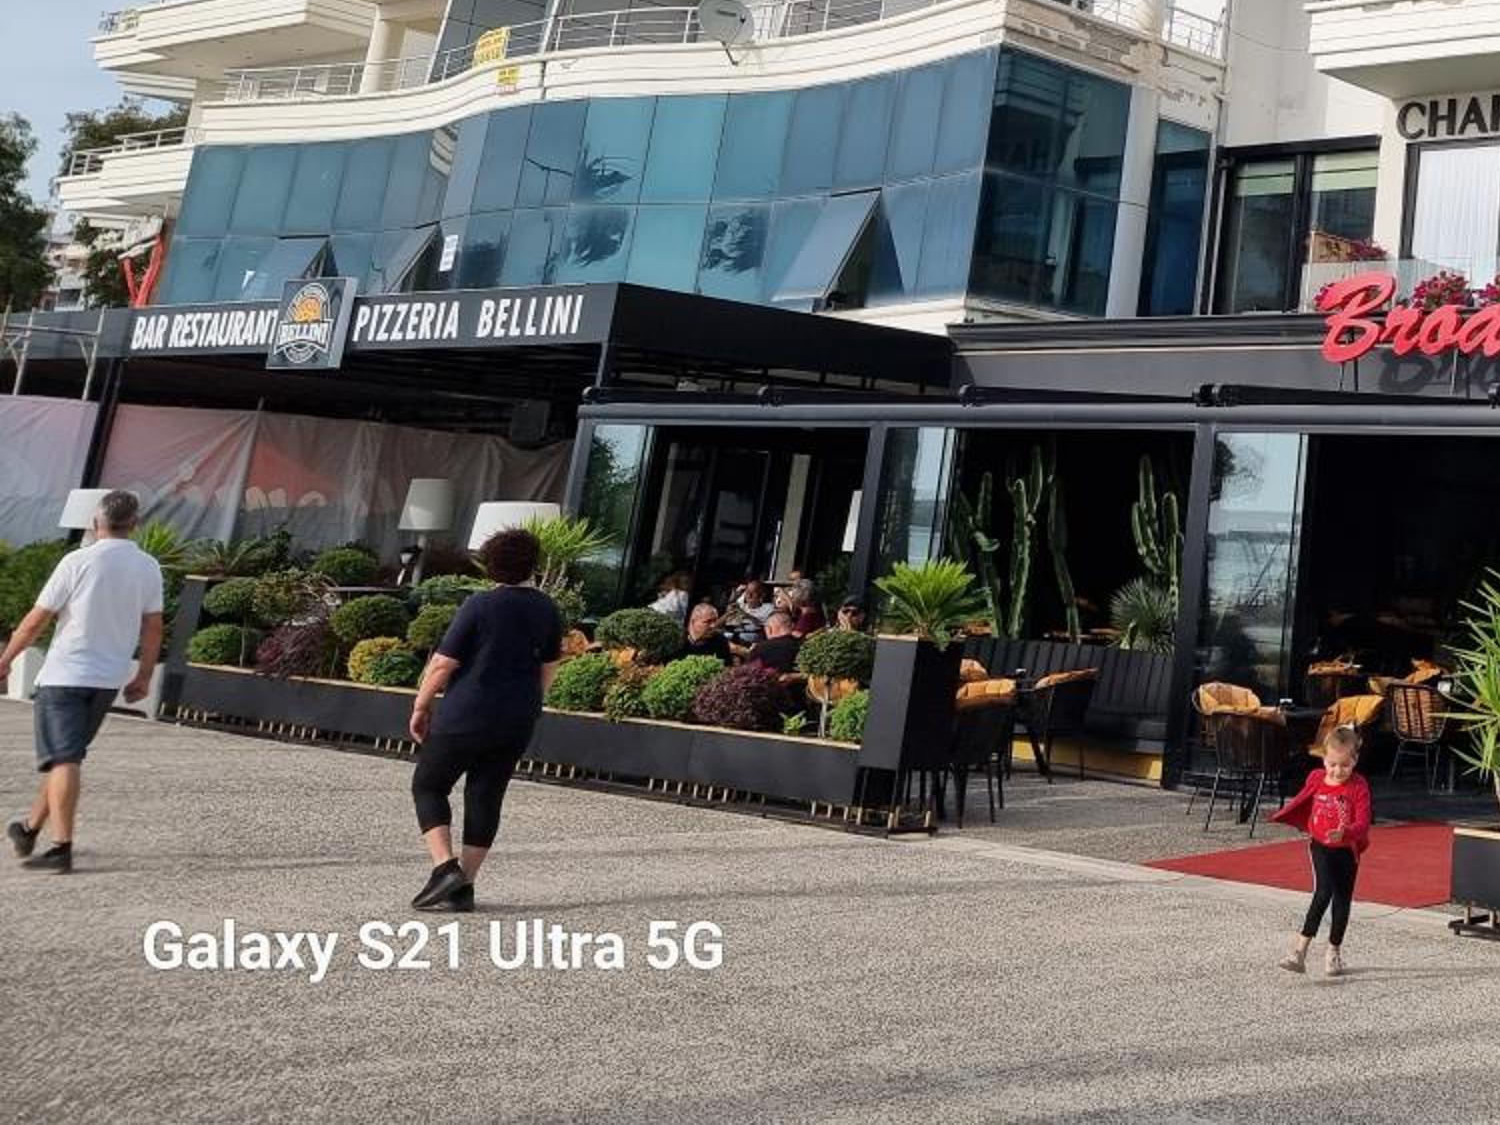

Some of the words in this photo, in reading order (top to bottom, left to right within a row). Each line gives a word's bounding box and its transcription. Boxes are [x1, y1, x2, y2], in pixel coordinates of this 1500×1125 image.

[131, 315, 168, 350] BAR
[277, 322, 330, 346] BELLINI
[352, 301, 460, 342] PIZZERIA
[475, 294, 584, 338] BELLINI
